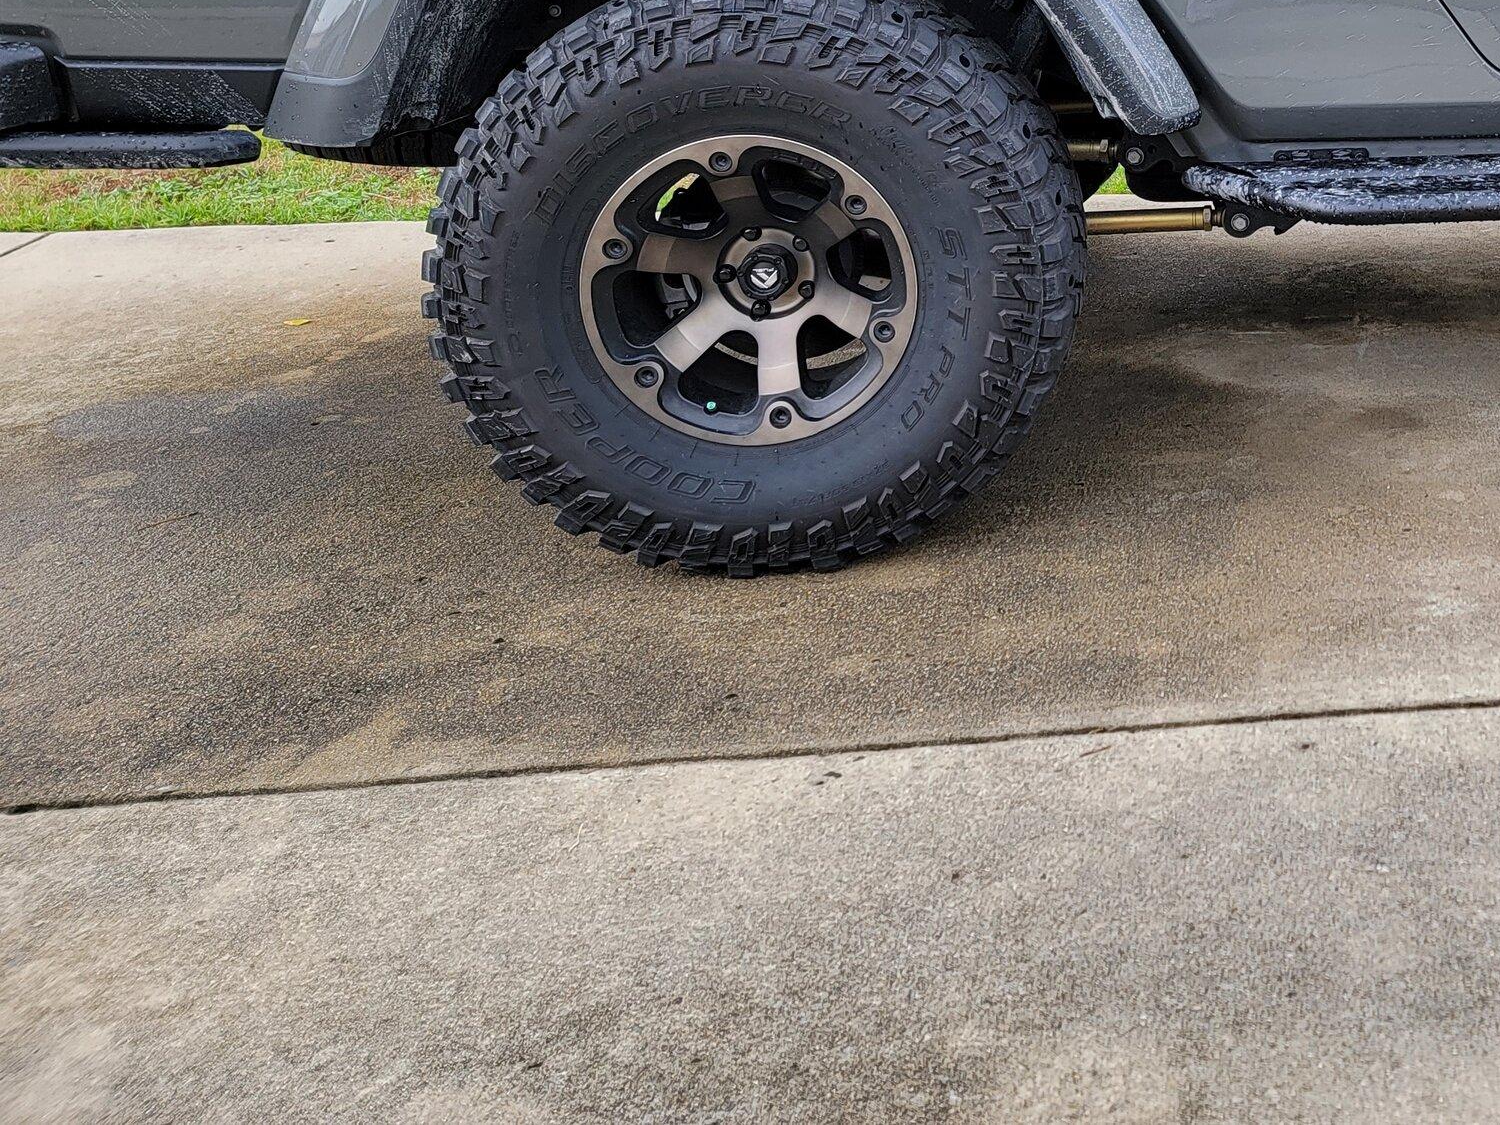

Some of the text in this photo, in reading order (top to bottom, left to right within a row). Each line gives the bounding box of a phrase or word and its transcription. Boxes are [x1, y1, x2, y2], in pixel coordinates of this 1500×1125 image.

[935, 227, 972, 340] STT
[534, 363, 757, 504] COOPER
[901, 343, 955, 432] PRO
